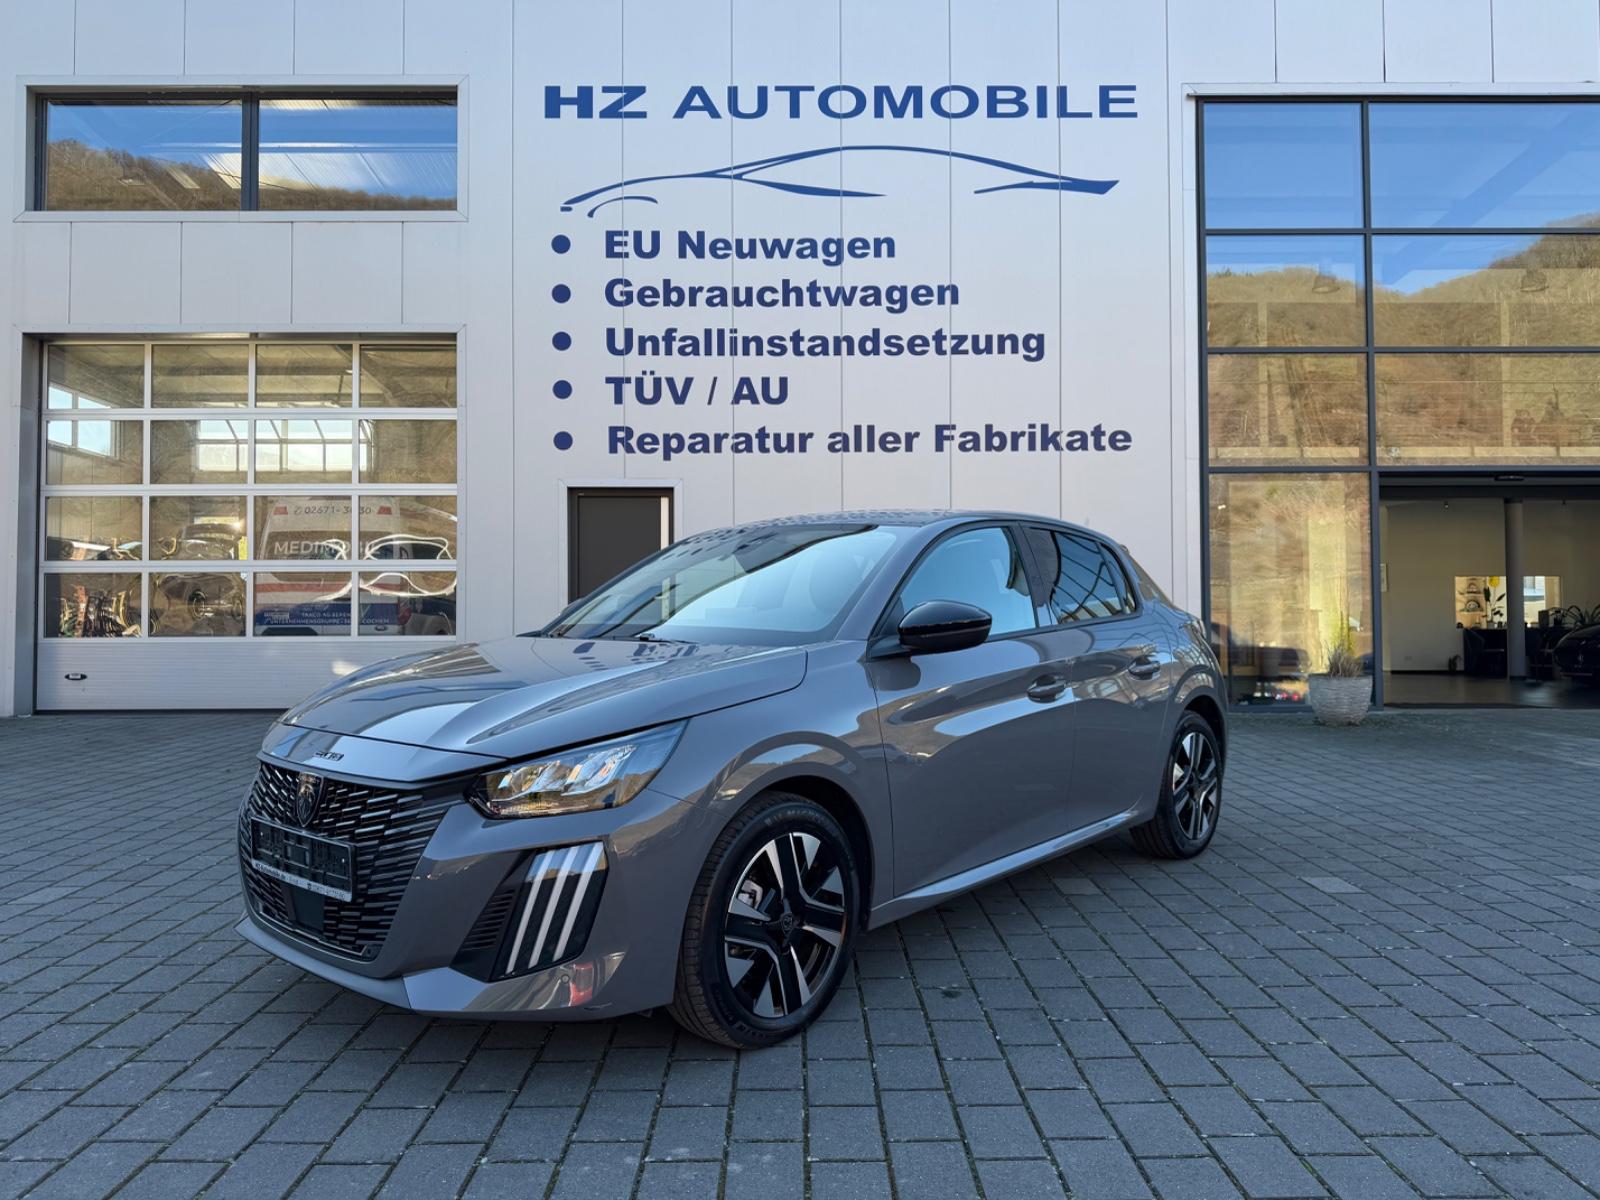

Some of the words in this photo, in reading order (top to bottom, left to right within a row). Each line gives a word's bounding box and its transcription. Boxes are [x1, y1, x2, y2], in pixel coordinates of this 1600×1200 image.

[544, 85, 648, 119] HZ
[672, 84, 1138, 119] AUTOMOBILE
[605, 230, 661, 260] EU
[677, 230, 896, 267] Neuwagen
[604, 277, 960, 315] Gebrauchtwagen
[605, 327, 1046, 363] Unfallinstandsetzung
[604, 370, 694, 406] TÜV
[707, 376, 718, 406] /
[731, 376, 789, 406] AU
[608, 425, 814, 462] Reparatur
[827, 424, 921, 454] aller
[934, 423, 1132, 453] Fabrikate
